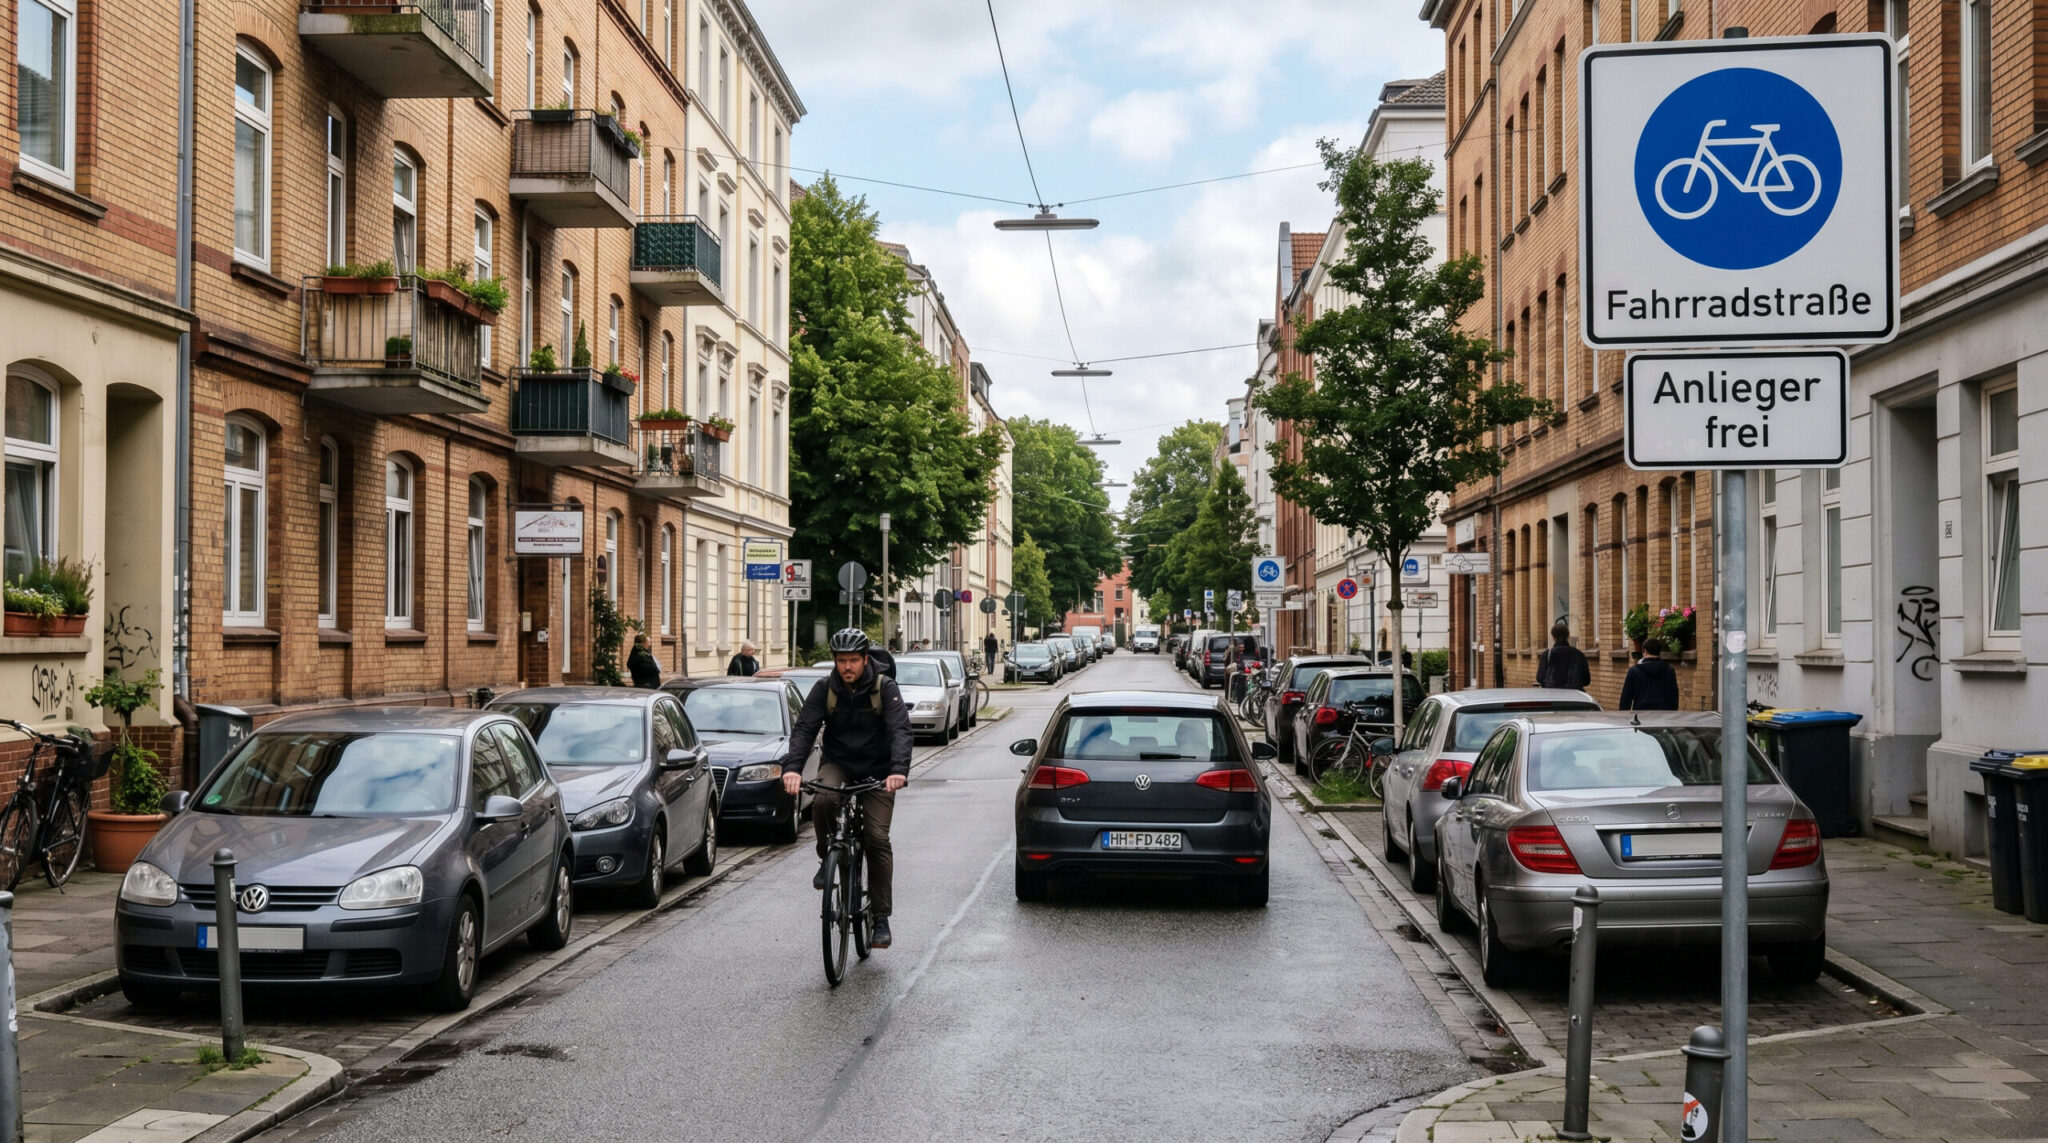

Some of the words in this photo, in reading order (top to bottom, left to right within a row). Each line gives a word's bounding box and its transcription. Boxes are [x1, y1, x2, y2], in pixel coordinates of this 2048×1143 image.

[1607, 283, 1872, 320] Fahrradstraße
[1653, 370, 1822, 412] Anlieger
[1705, 415, 1770, 448] frei
[1110, 833, 1128, 846] HH
[1135, 834, 1153, 847] FD
[1155, 834, 1180, 847] 482
